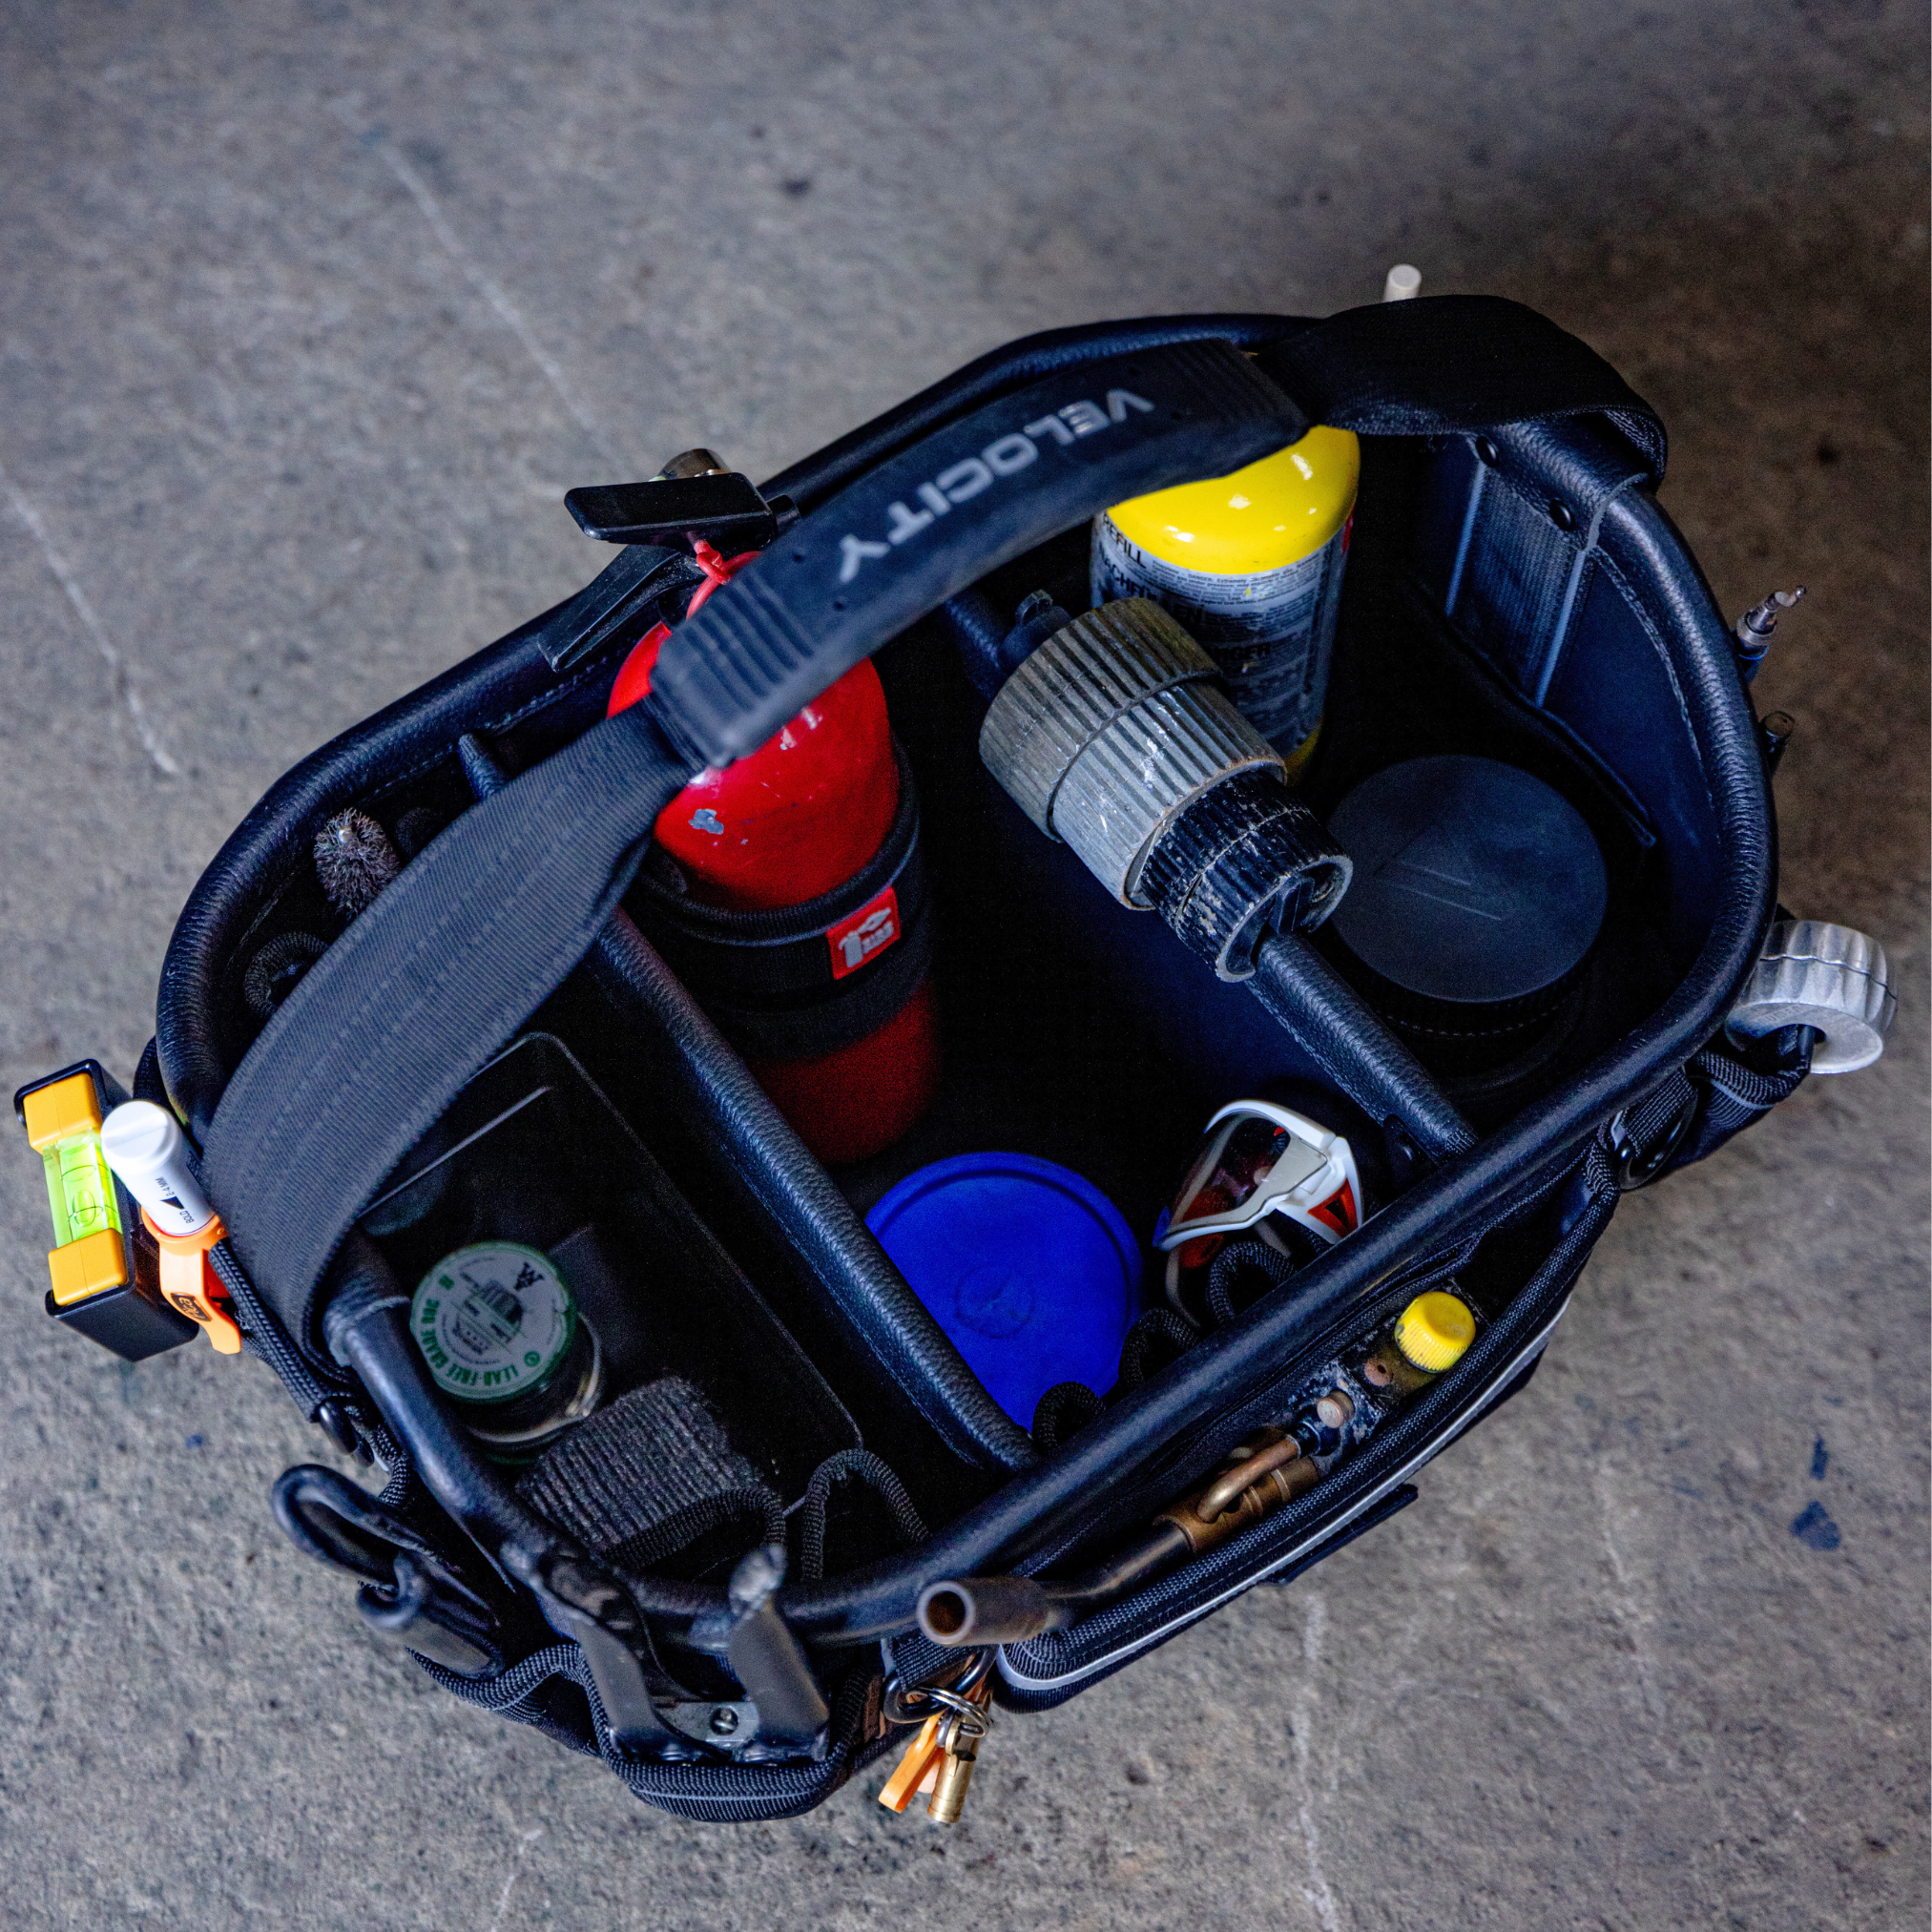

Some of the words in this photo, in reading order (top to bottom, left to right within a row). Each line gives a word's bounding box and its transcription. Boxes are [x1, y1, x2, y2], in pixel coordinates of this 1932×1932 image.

[839, 387, 1155, 584] VELOCITY
[1103, 512, 1147, 569] REFILL
[179, 1210, 195, 1224] BOLD
